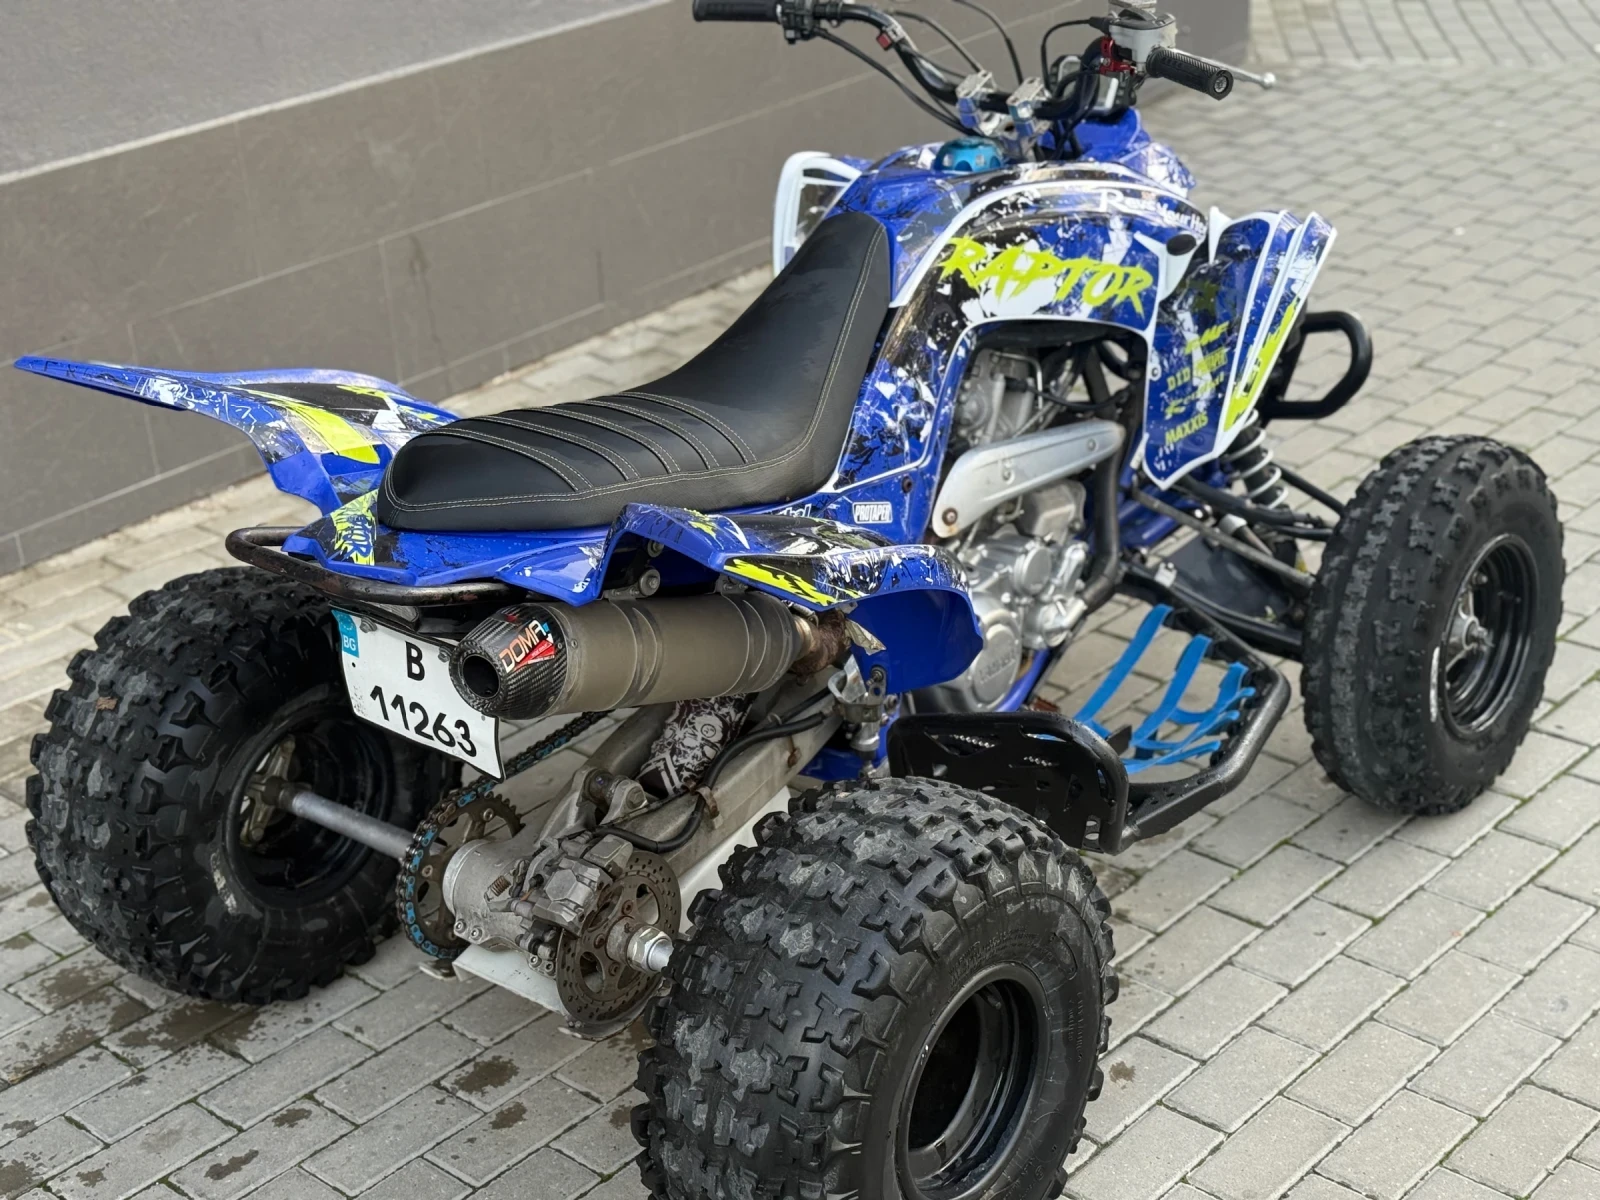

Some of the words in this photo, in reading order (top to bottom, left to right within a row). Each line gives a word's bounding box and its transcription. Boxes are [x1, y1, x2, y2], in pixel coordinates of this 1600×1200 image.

[937, 234, 1153, 320] RAPTOR
[1165, 412, 1208, 446] MAXXIS
[855, 504, 891, 522] PROTAPER
[342, 635, 357, 651] BG
[405, 641, 425, 681] B
[499, 620, 546, 673] DOMA
[369, 685, 477, 757] 11263
